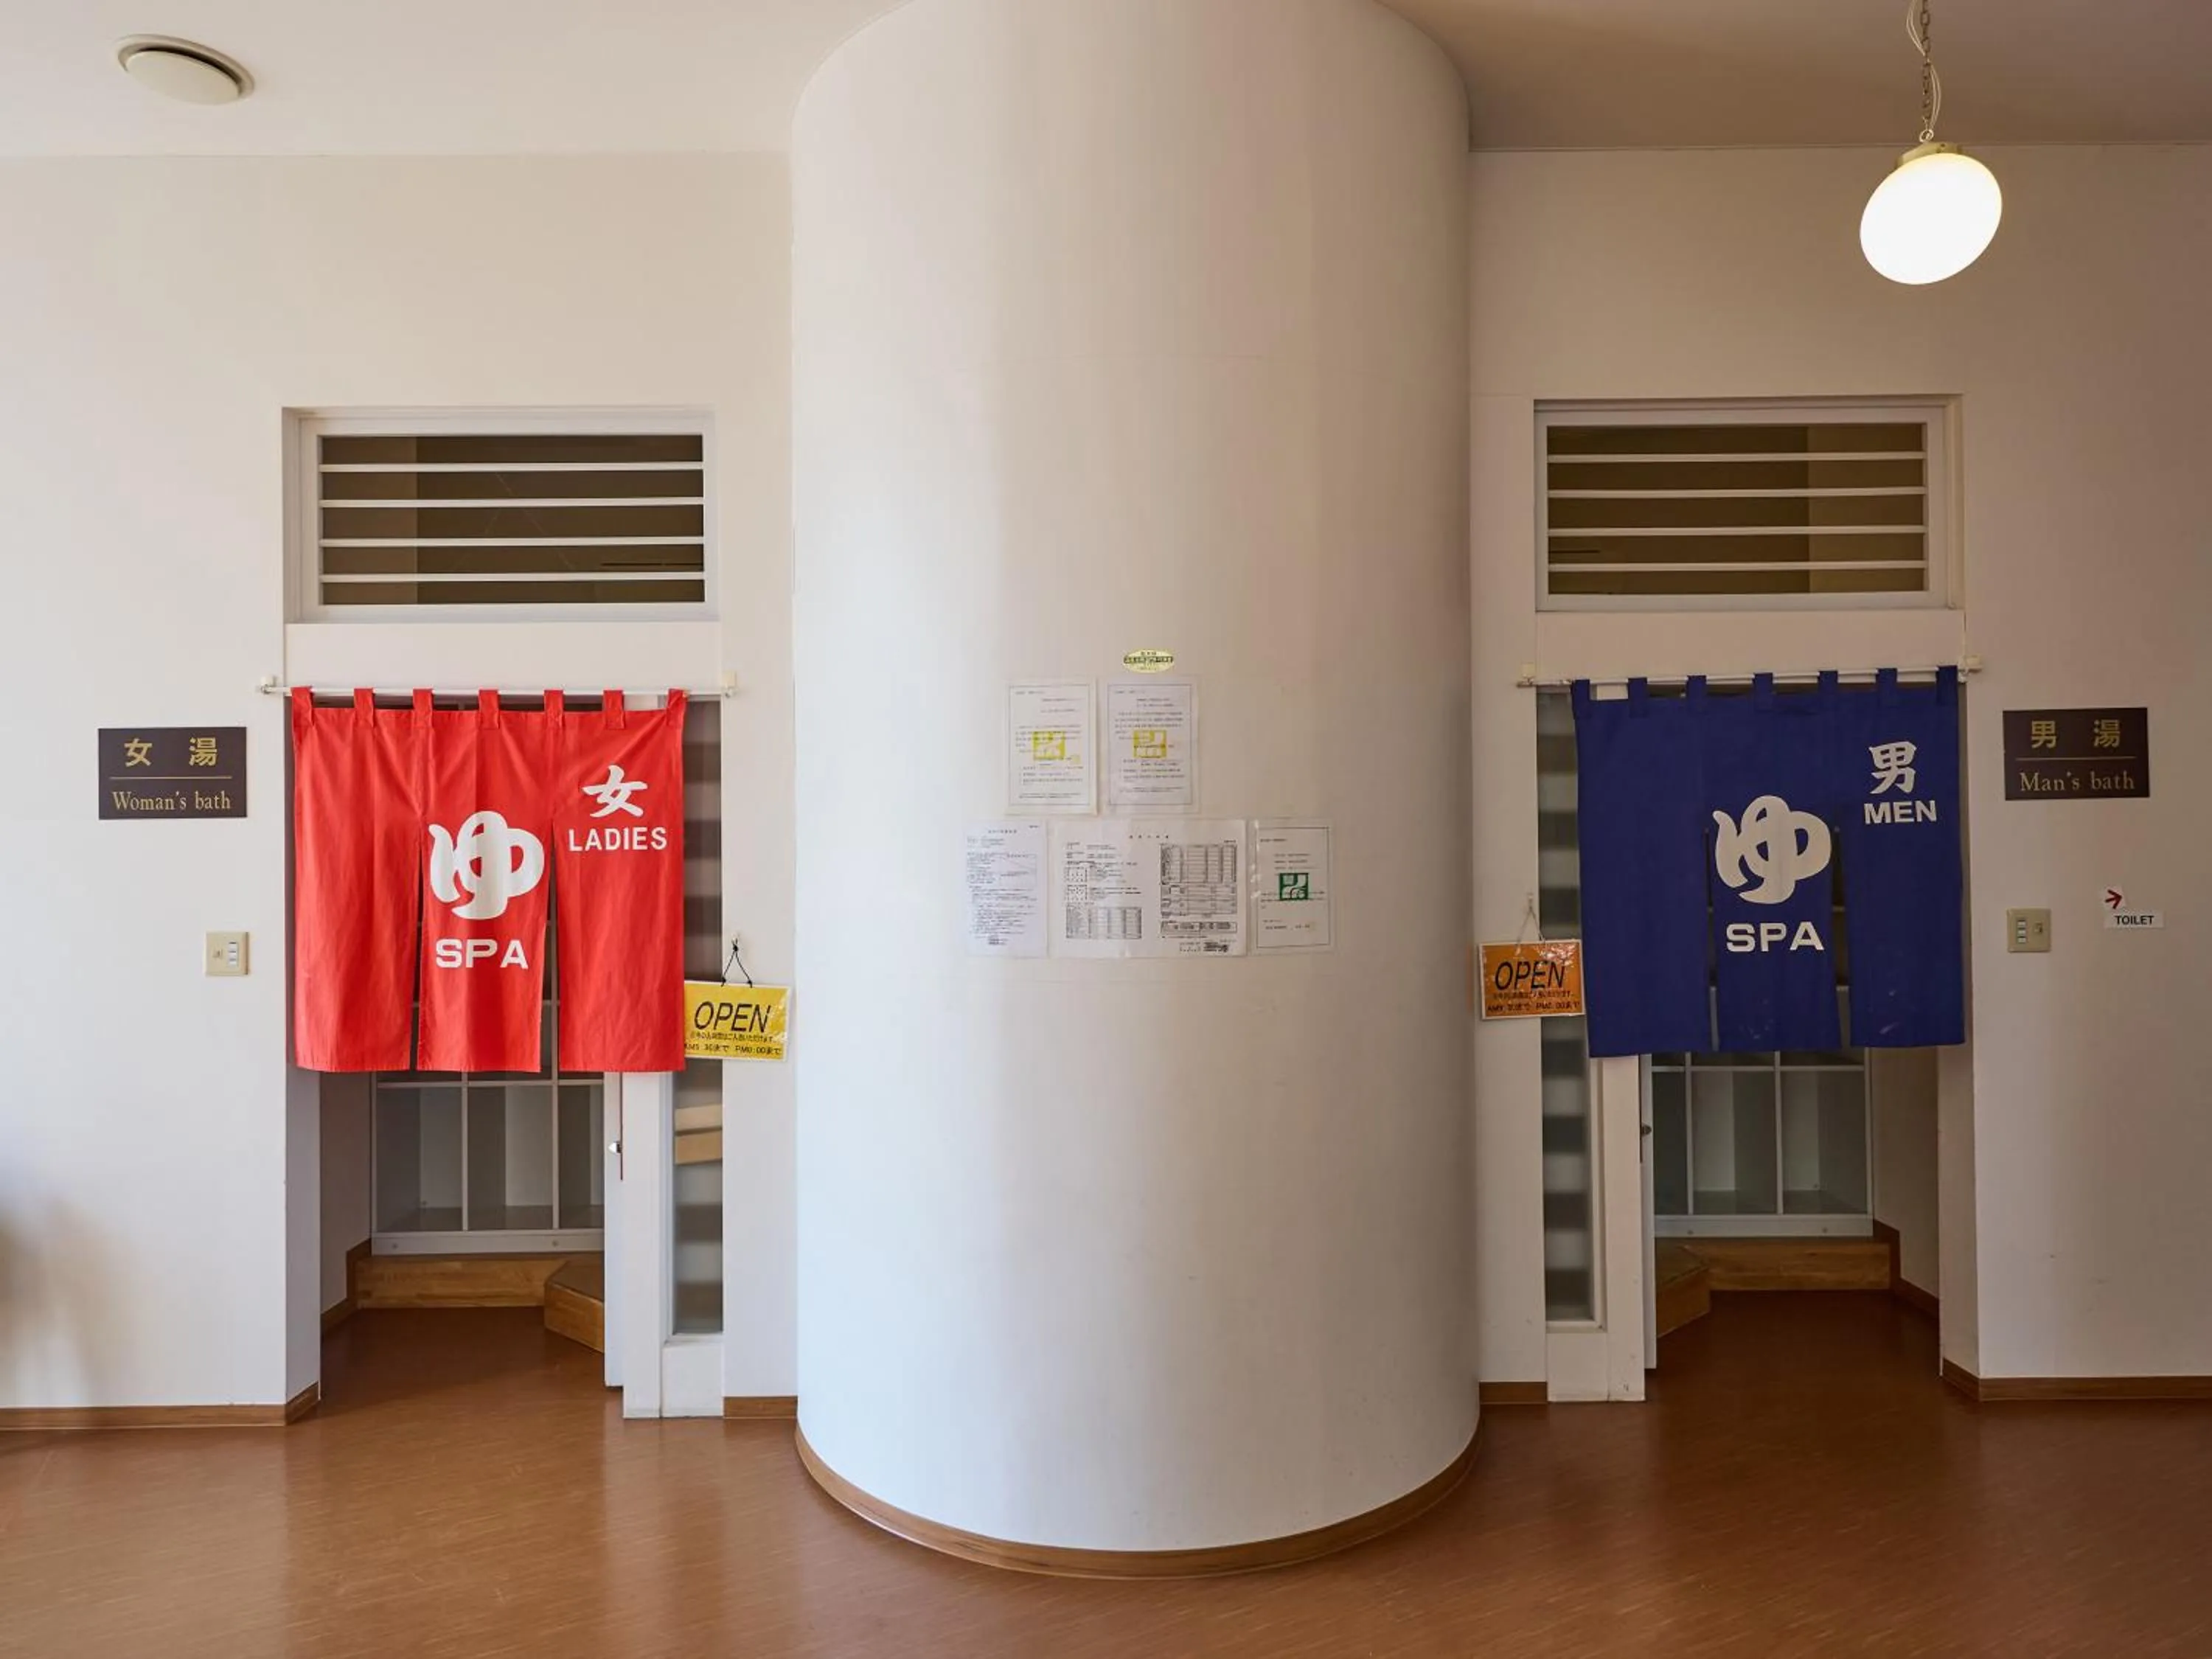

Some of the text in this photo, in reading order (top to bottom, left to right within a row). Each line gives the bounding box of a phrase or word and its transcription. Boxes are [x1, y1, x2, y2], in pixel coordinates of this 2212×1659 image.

[1868, 740, 1917, 794] 男
[2020, 771, 2135, 792] Man's bath
[112, 790, 231, 810] Woman's bath
[582, 765, 648, 818] 女
[1863, 800, 1938, 824] MEN
[568, 827, 667, 852] LADIES
[1712, 794, 1832, 905] ゆ
[428, 810, 545, 920] ゆ
[2115, 915, 2154, 925] TOILET
[1726, 922, 1825, 953] SPA
[436, 938, 529, 970] SPA
[1495, 961, 1565, 991] OPEN
[694, 1001, 771, 1033] OPEN
